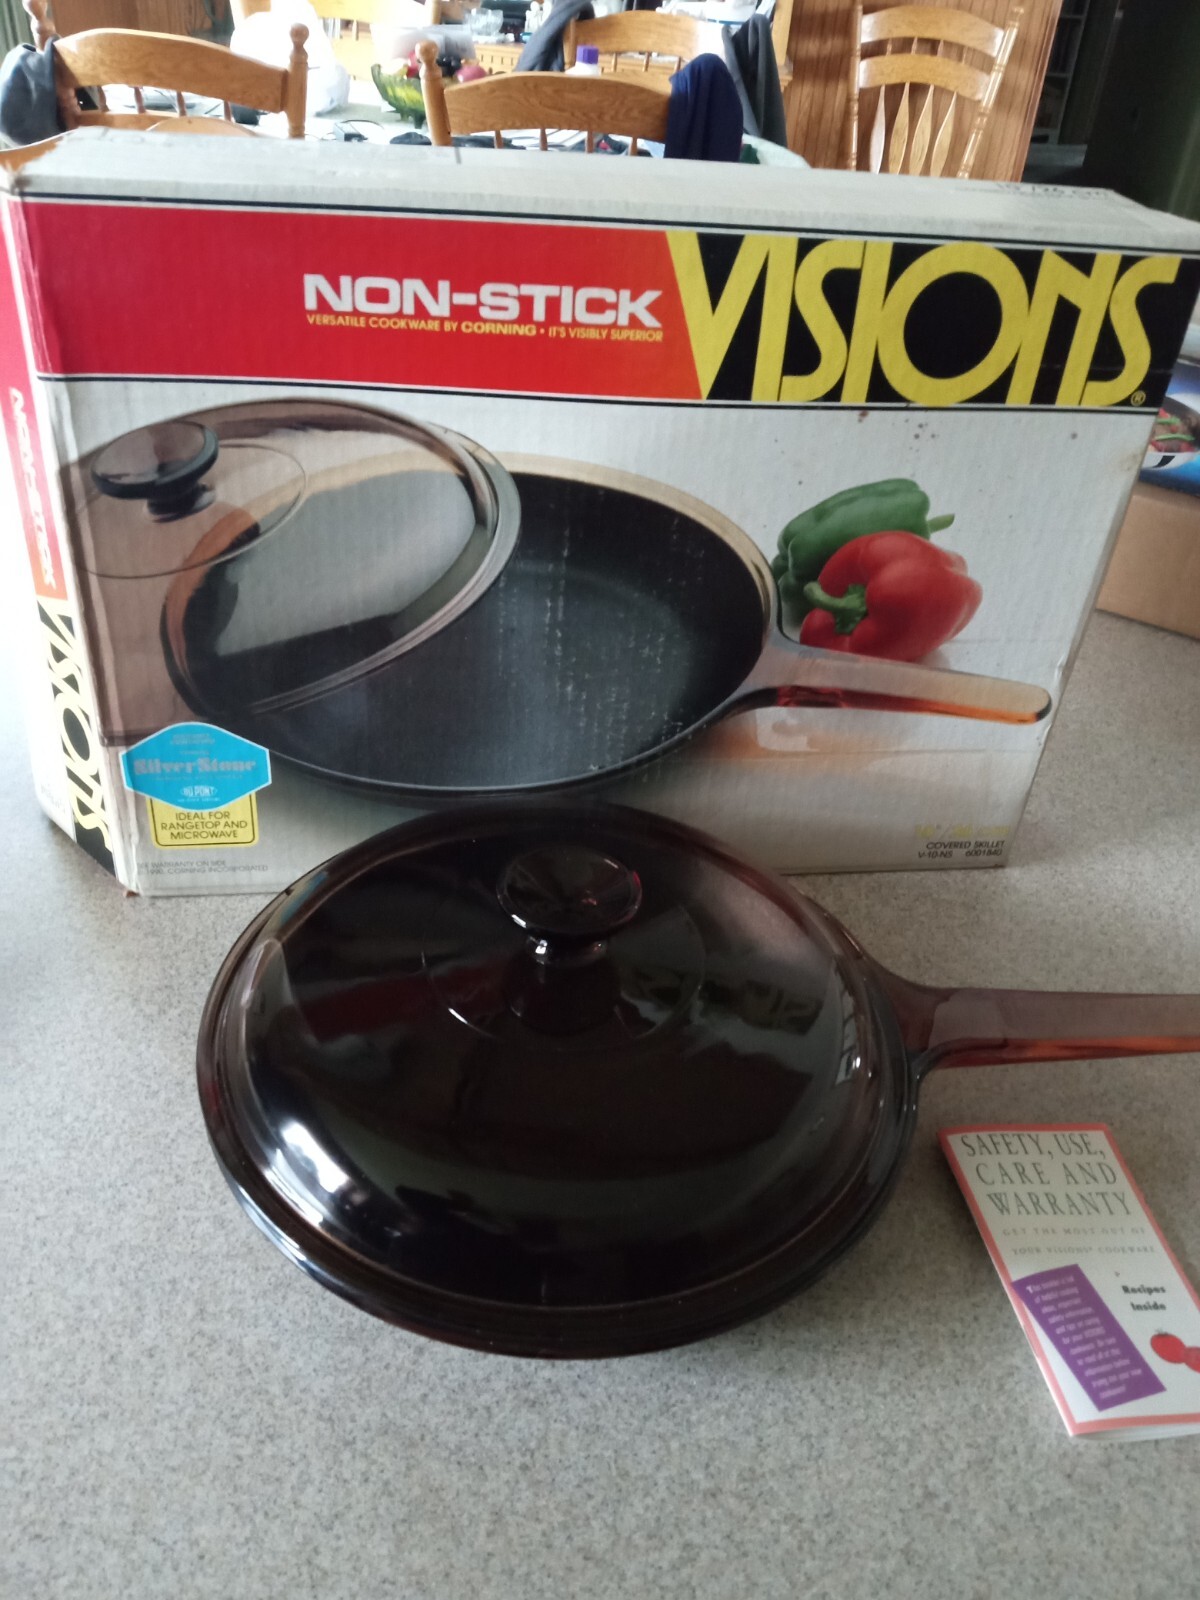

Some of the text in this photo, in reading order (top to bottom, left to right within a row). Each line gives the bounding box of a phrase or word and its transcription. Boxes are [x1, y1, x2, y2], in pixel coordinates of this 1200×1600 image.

[303, 273, 663, 328] NON-STICK
[665, 230, 1182, 407] VISIONS
[306, 314, 664, 343] VERSATILE COOKWARE BY CORNING IT'S VISIBLY SUPERIOR
[161, 820, 248, 830] RANGETOP AND
[175, 811, 230, 821] IDEAL FOR
[170, 830, 239, 840] MICROWAVE
[926, 840, 1005, 850] COVERED SKILLET
[960, 1133, 1106, 1160] SAFETY, USE,
[975, 1162, 1118, 1186] CARE AND
[987, 1191, 1133, 1216] WARRANTY
[1121, 1284, 1166, 1296] Recipes
[1130, 1301, 1167, 1312] Inside
